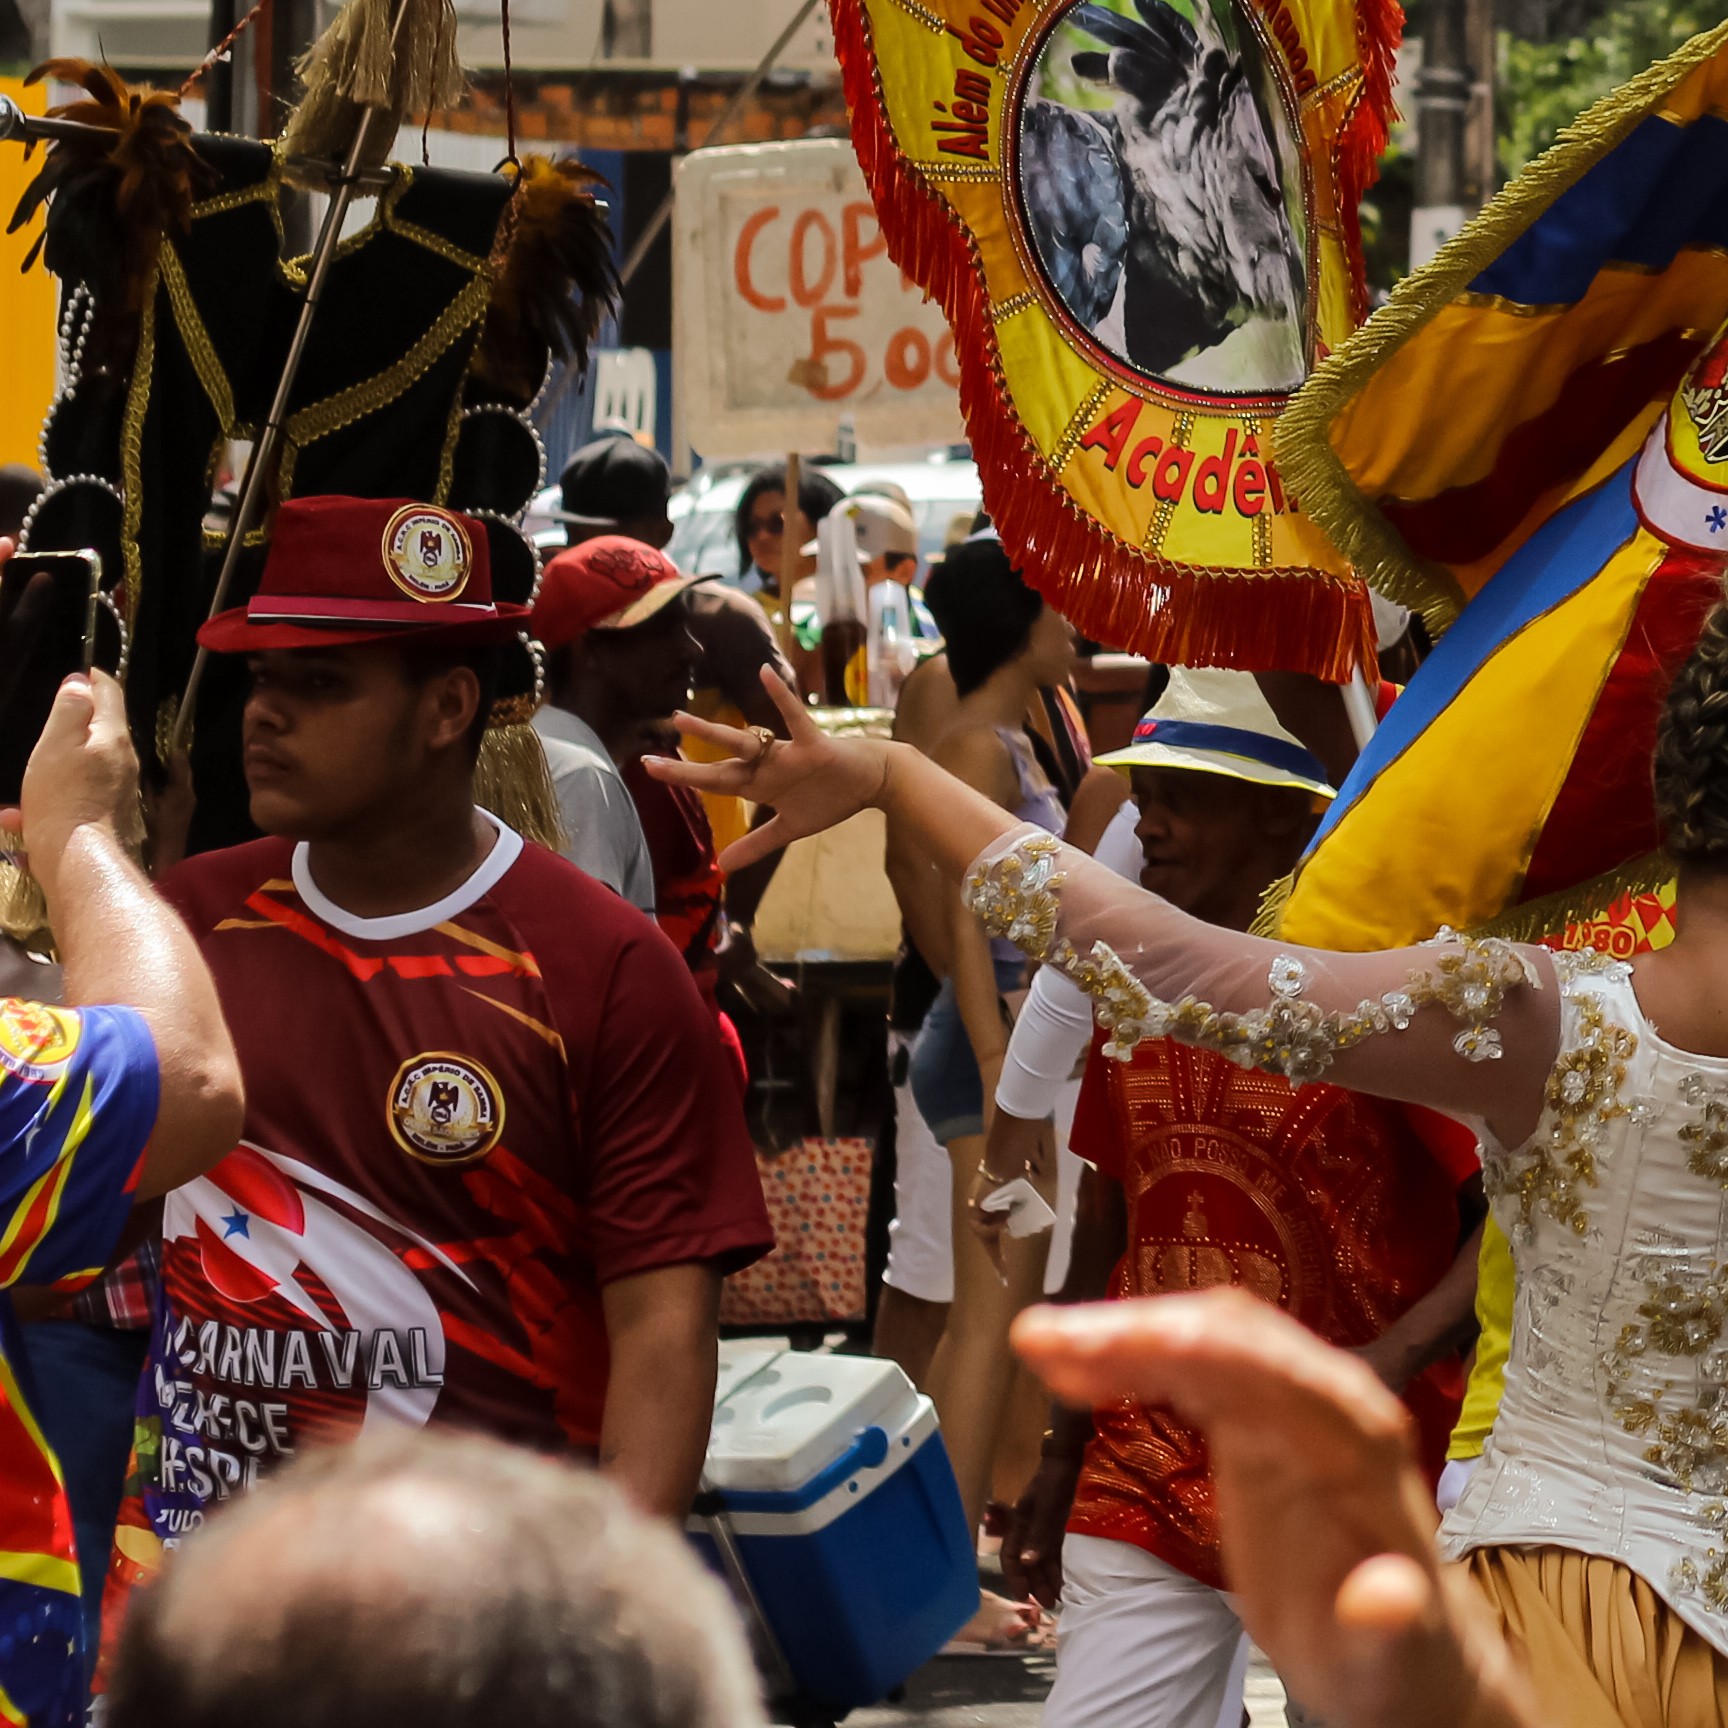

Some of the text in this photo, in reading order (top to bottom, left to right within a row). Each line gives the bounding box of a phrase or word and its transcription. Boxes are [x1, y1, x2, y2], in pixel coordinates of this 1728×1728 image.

[944, 19, 1005, 68] do
[930, 72, 992, 161] Além
[734, 202, 918, 312] COP
[173, 1315, 446, 1392] CARNAVAL
